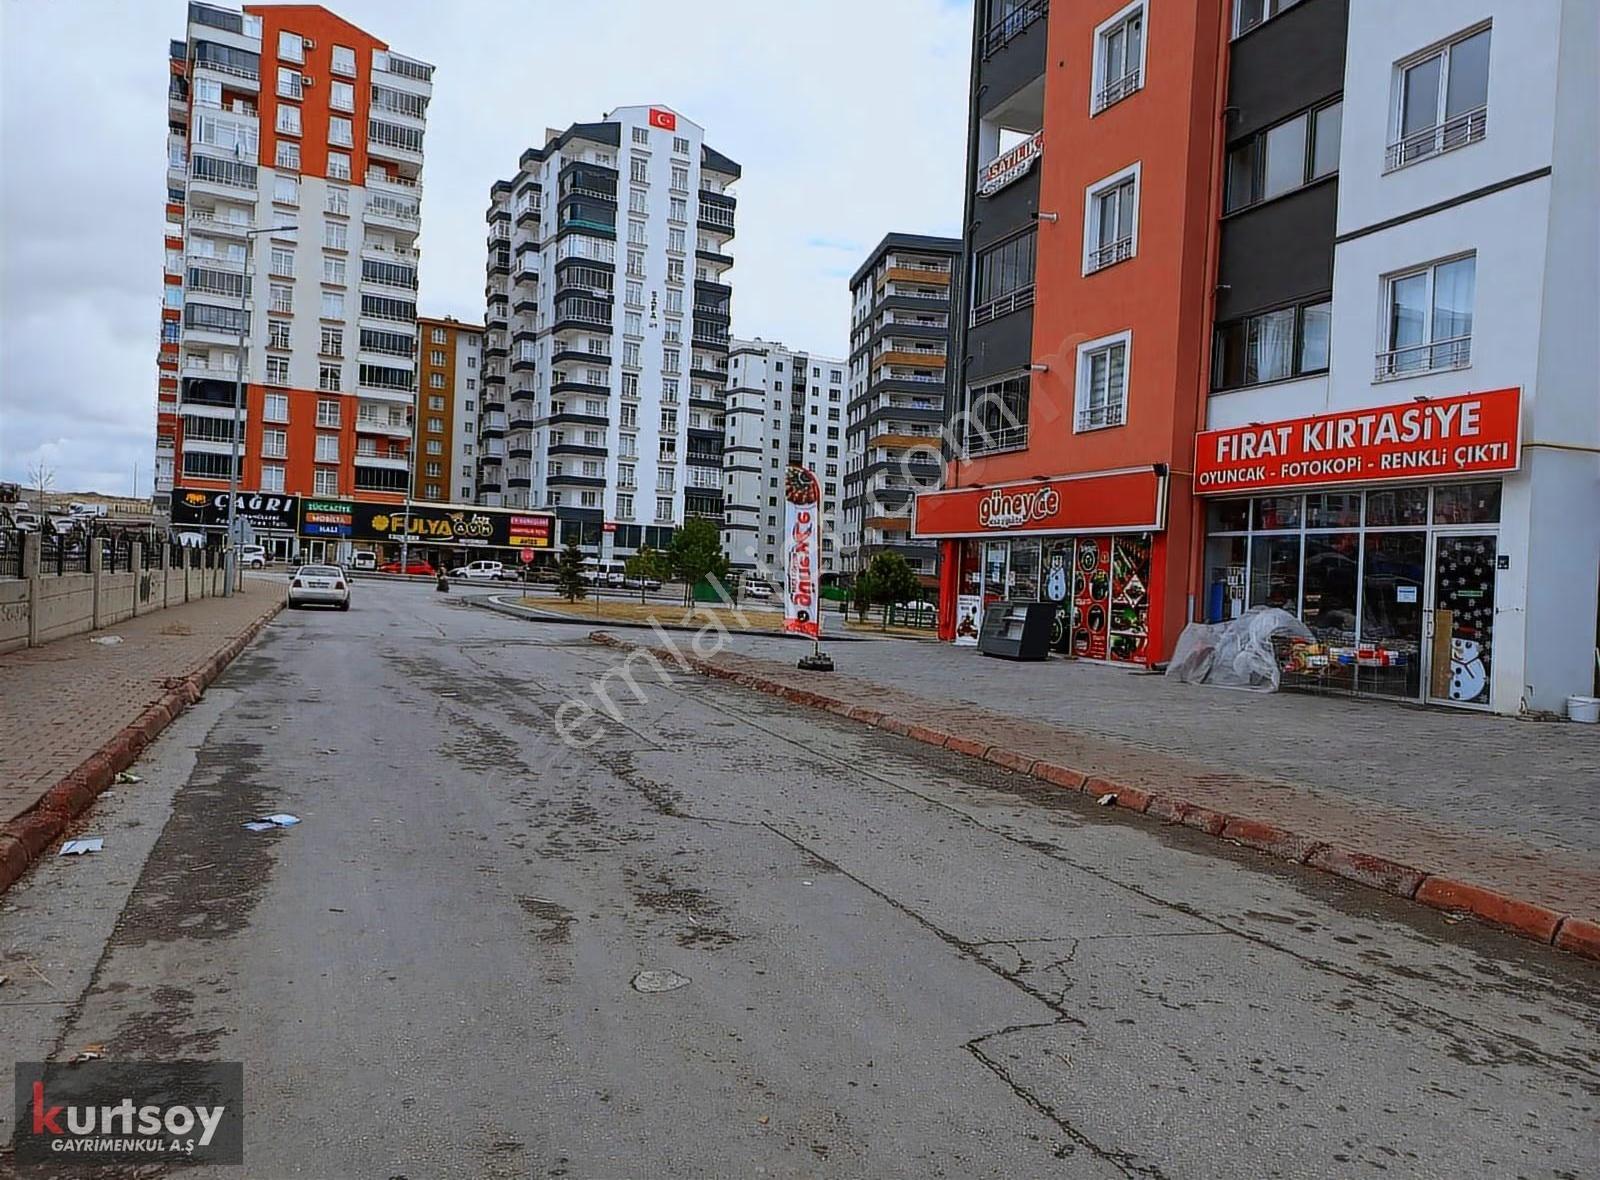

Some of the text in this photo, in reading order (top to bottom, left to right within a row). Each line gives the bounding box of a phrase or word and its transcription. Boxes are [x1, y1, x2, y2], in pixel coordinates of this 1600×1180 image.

[1216, 426, 1292, 462] FIRAT
[1200, 466, 1265, 486] OYUNCAK
[1454, 443, 1508, 469] ÇIKTI
[214, 493, 292, 513] ÇAĞRI
[391, 516, 453, 536] FULYA
